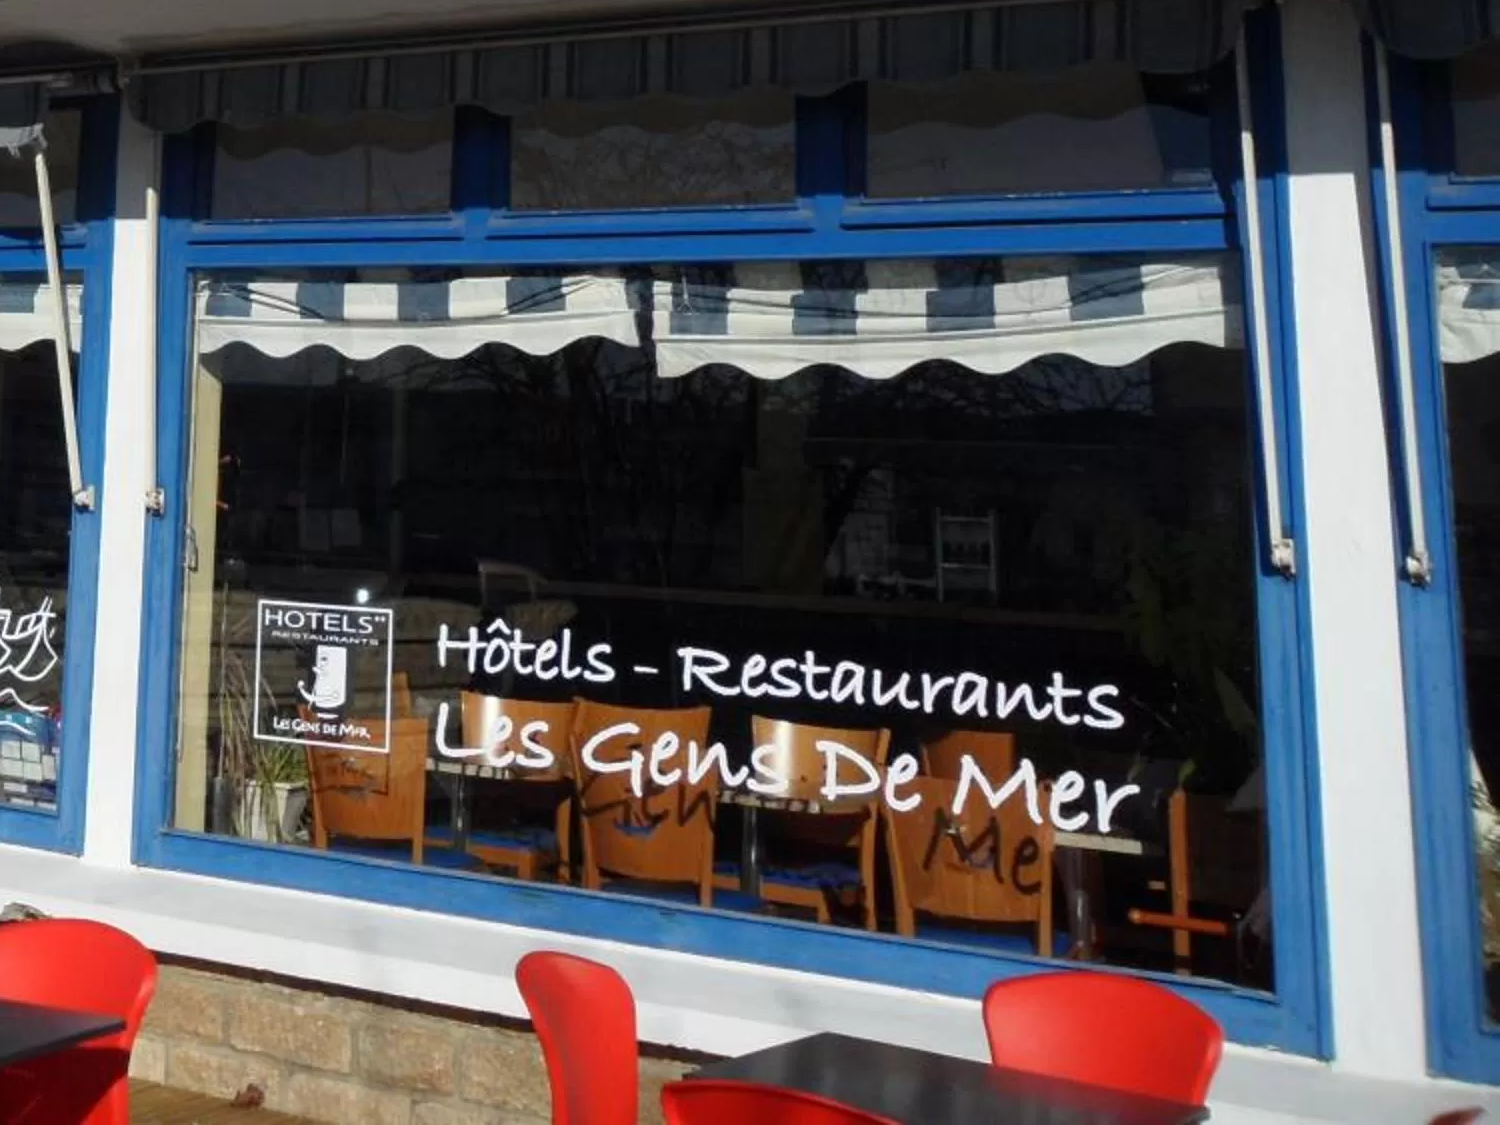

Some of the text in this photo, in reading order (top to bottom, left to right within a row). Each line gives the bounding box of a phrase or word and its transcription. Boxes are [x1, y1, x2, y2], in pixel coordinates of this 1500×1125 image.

[436, 617, 617, 683] Hôtels
[676, 646, 1126, 730] Restaurants
[434, 701, 1142, 835] Les Gens De Mer
